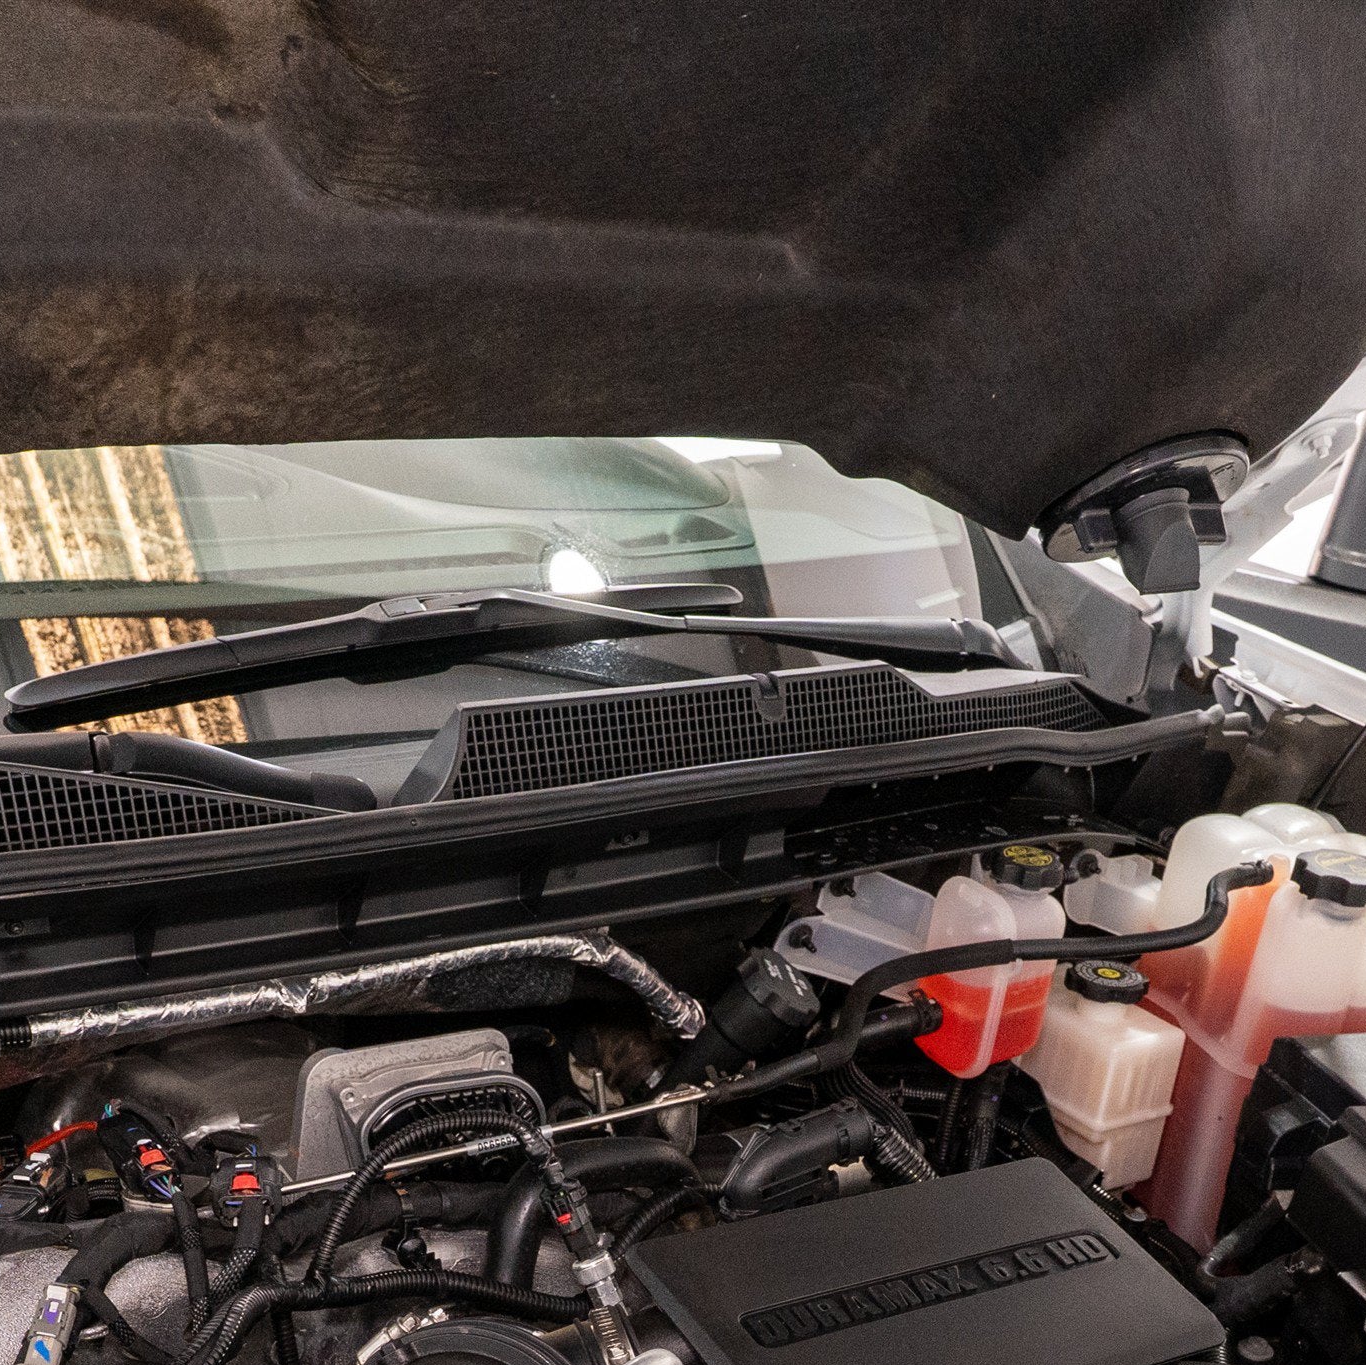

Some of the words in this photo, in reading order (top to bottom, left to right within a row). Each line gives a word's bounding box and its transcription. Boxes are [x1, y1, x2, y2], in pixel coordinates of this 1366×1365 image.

[749, 1264, 976, 1345] DURAMAX
[979, 1244, 1051, 1285] 6.6
[1052, 1233, 1110, 1266] HD
